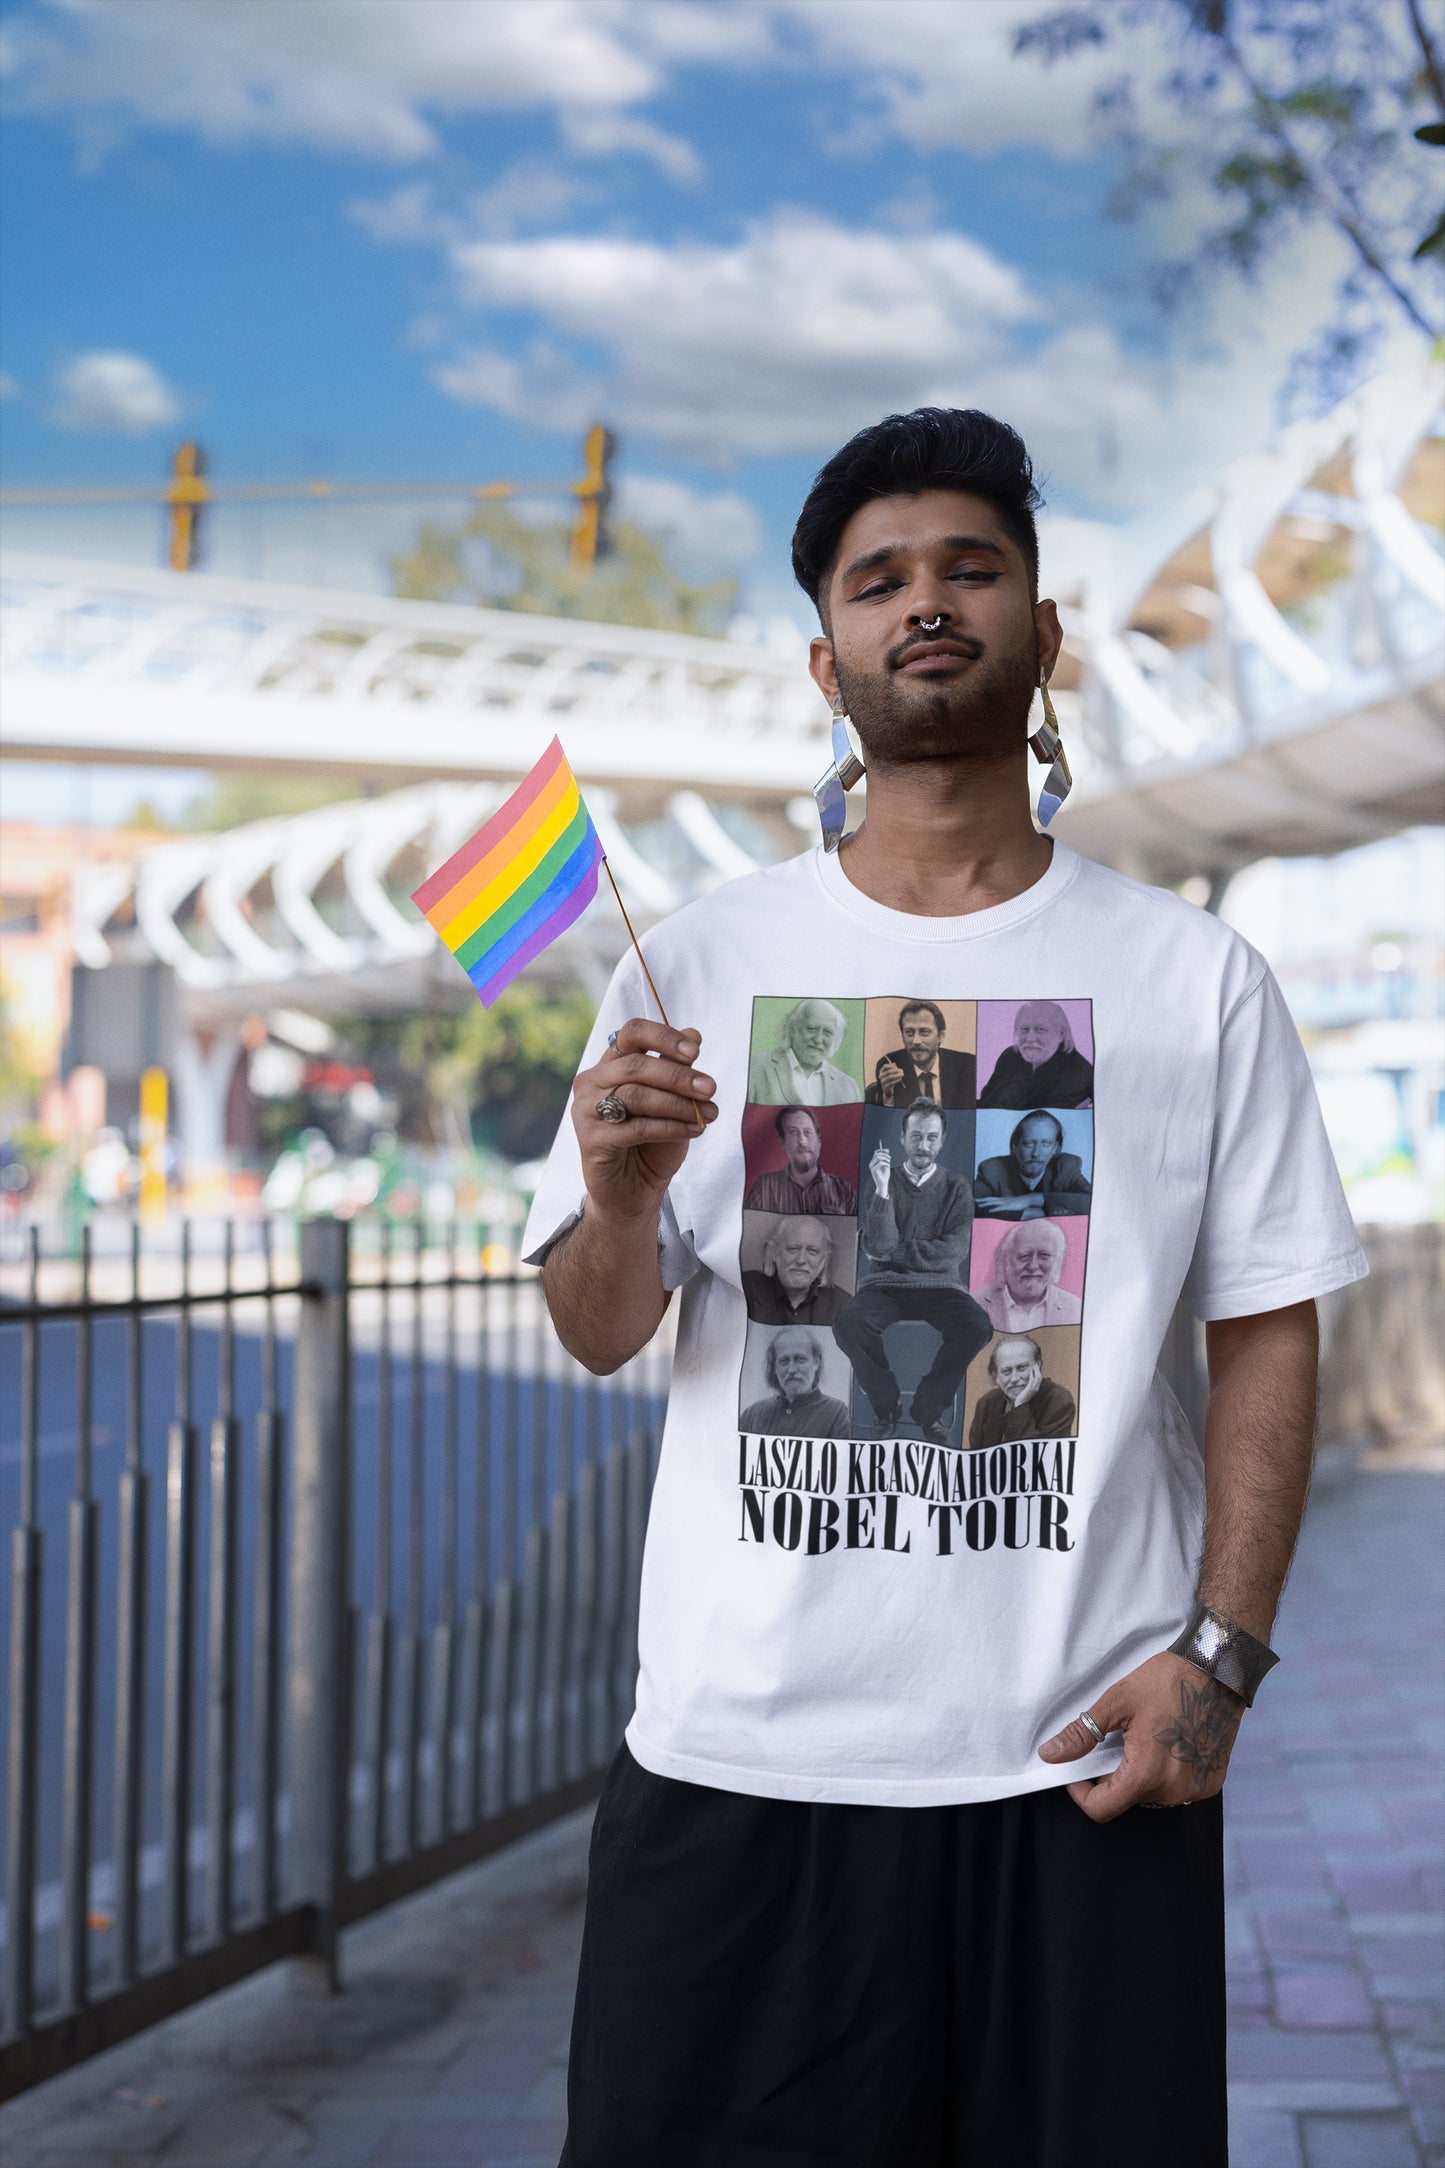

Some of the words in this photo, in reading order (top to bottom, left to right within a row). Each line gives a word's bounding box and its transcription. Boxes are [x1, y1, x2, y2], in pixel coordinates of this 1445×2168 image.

[737, 1435, 838, 1495] LASZLO
[847, 1440, 1078, 1503] KRASZNAHORKAI
[737, 1488, 911, 1556] NOBEL
[928, 1494, 1076, 1556] TOUR
